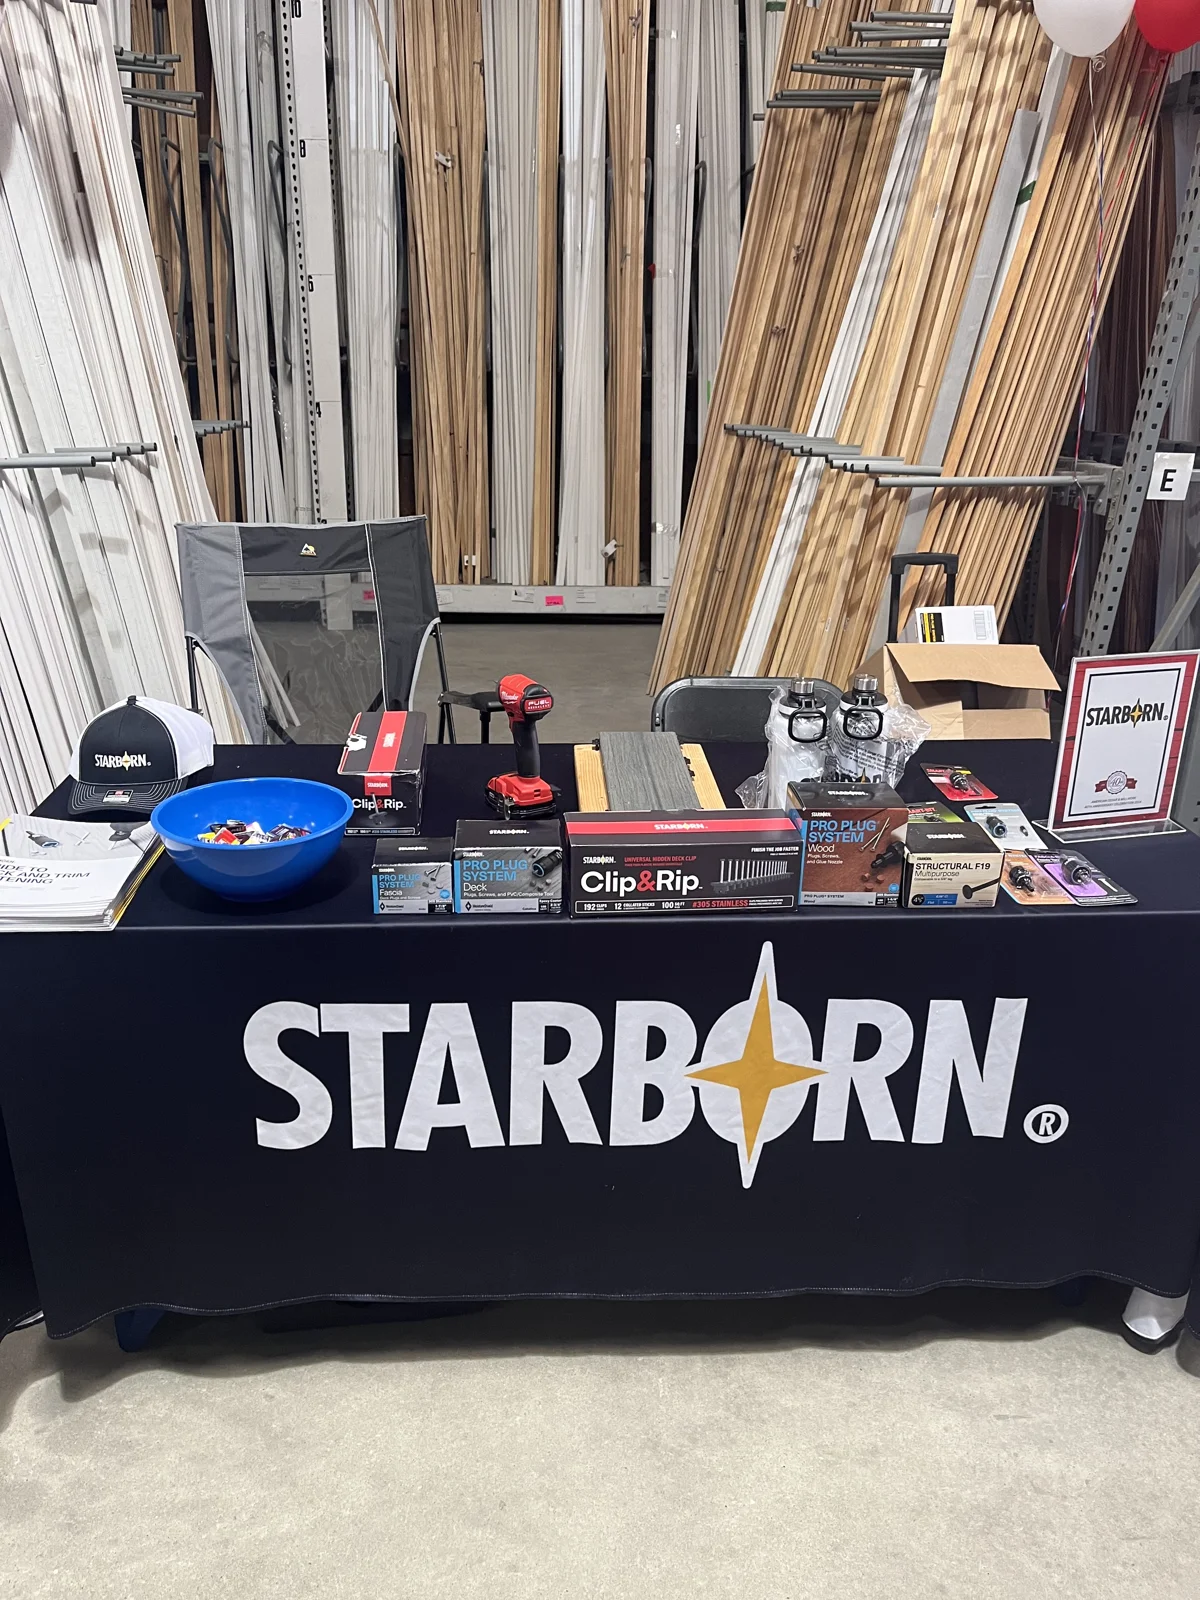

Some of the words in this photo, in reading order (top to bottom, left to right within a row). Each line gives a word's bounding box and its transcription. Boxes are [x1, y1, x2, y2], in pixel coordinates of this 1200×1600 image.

[291, 0, 302, 18] 10
[299, 139, 307, 158] 8
[307, 275, 314, 292] 6
[315, 402, 322, 418] 4
[1160, 469, 1177, 492] E
[528, 699, 550, 707] FUEL
[810, 820, 838, 831] PRO
[808, 832, 864, 843] SYSTEM
[807, 843, 835, 853] Wood
[583, 855, 617, 865] STARBORN
[463, 860, 490, 871] PRO
[493, 860, 529, 871] PLUG
[379, 874, 396, 882] PRO
[463, 871, 518, 881] SYSTEM
[379, 881, 415, 889] SYSTEM
[463, 883, 488, 892] Deck
[583, 903, 596, 911] 192
